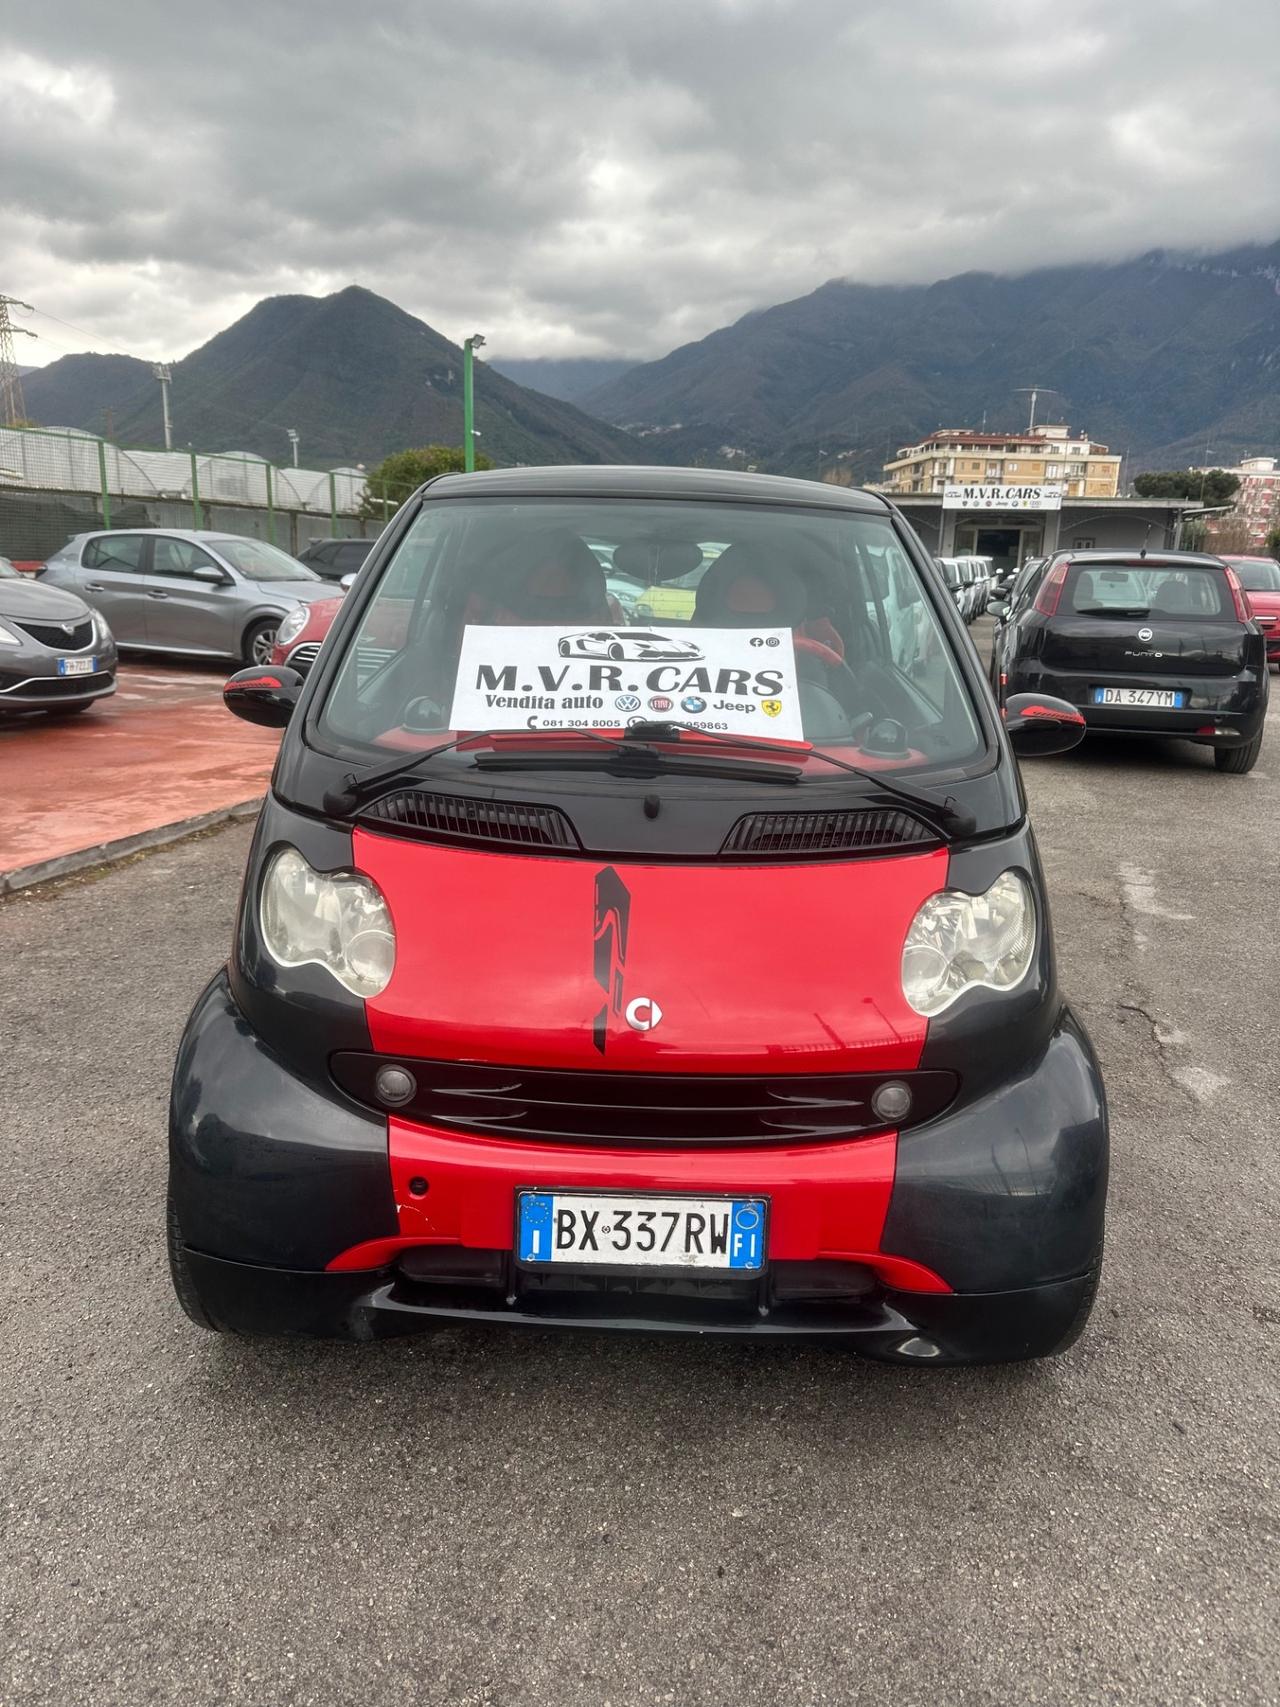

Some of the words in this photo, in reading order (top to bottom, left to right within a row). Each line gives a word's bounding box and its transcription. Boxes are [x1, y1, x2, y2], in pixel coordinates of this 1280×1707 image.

[485, 694, 556, 710] Vendita
[561, 695, 604, 710] auto
[713, 699, 756, 713] Jeep
[1105, 689, 1122, 703] DA
[1128, 690, 1173, 706] 347YM
[542, 719, 563, 727] 081
[567, 719, 590, 727] 304
[592, 719, 621, 727] 8005
[556, 1209, 600, 1251] BX
[612, 1210, 729, 1255] 337RW
